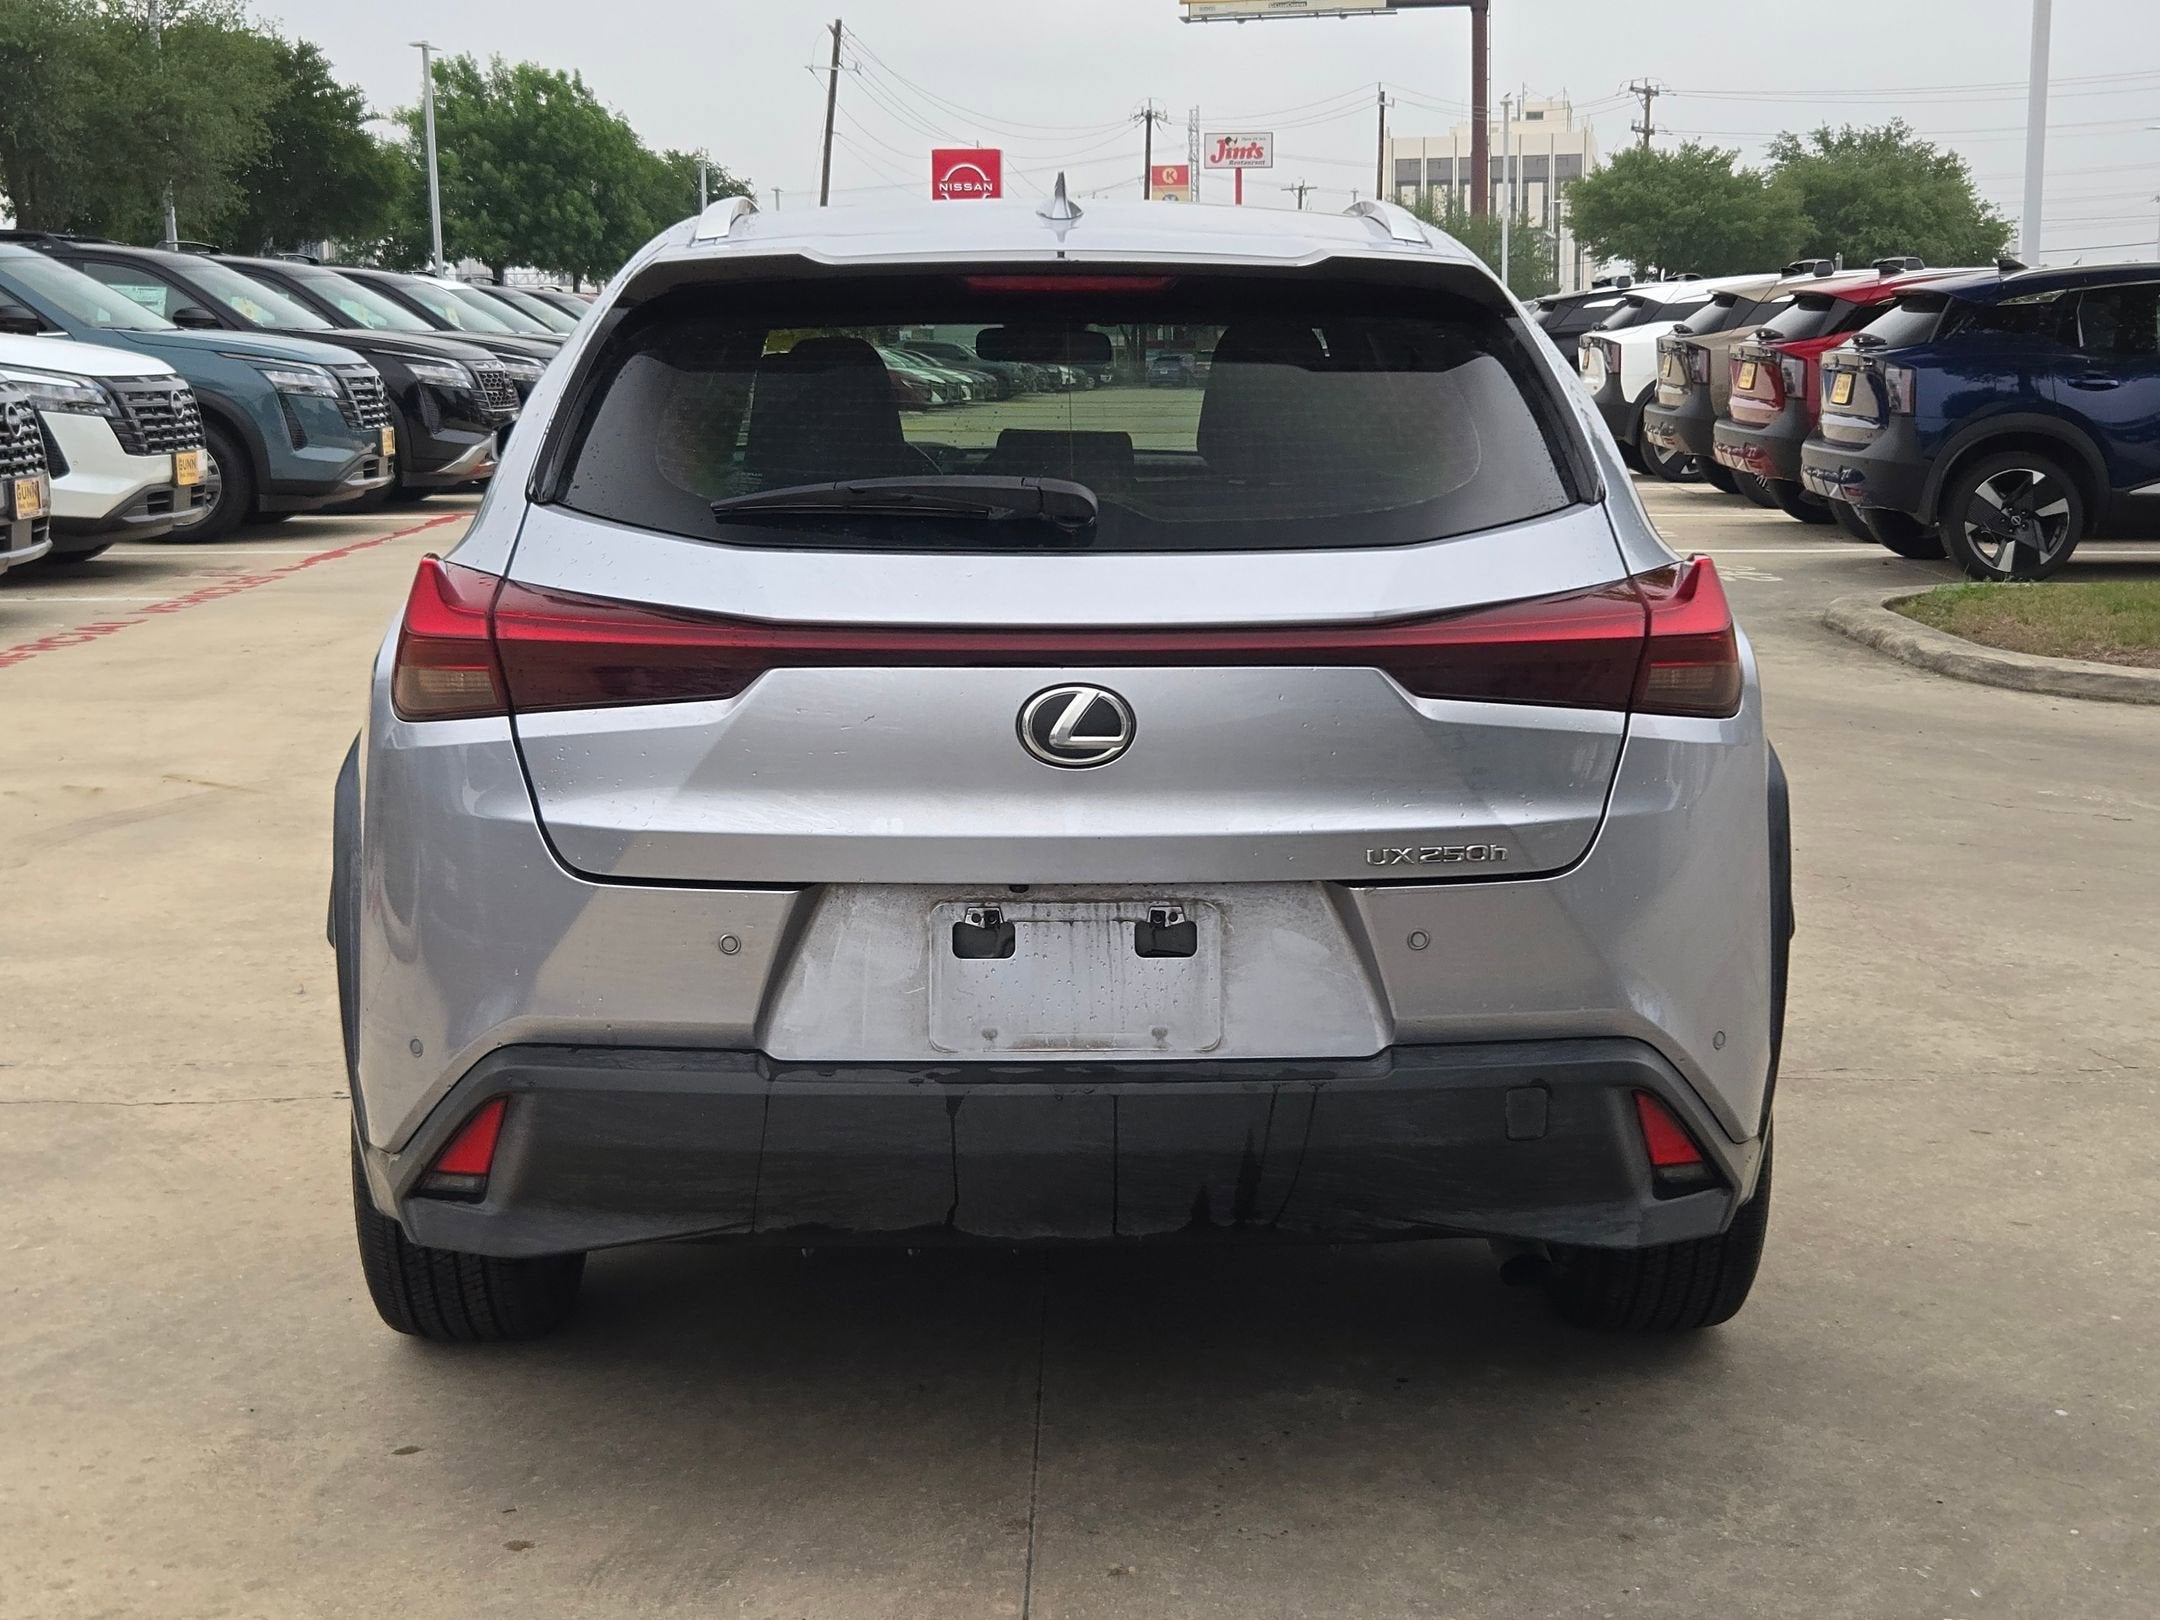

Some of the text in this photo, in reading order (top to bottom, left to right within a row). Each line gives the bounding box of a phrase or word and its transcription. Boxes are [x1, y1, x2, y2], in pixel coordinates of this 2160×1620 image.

[1210, 139, 1264, 164] Jim's
[939, 183, 993, 191] NISSAN
[179, 458, 197, 471] GUNN
[17, 484, 38, 500] GUNN
[1366, 844, 1509, 865] UX 250h
